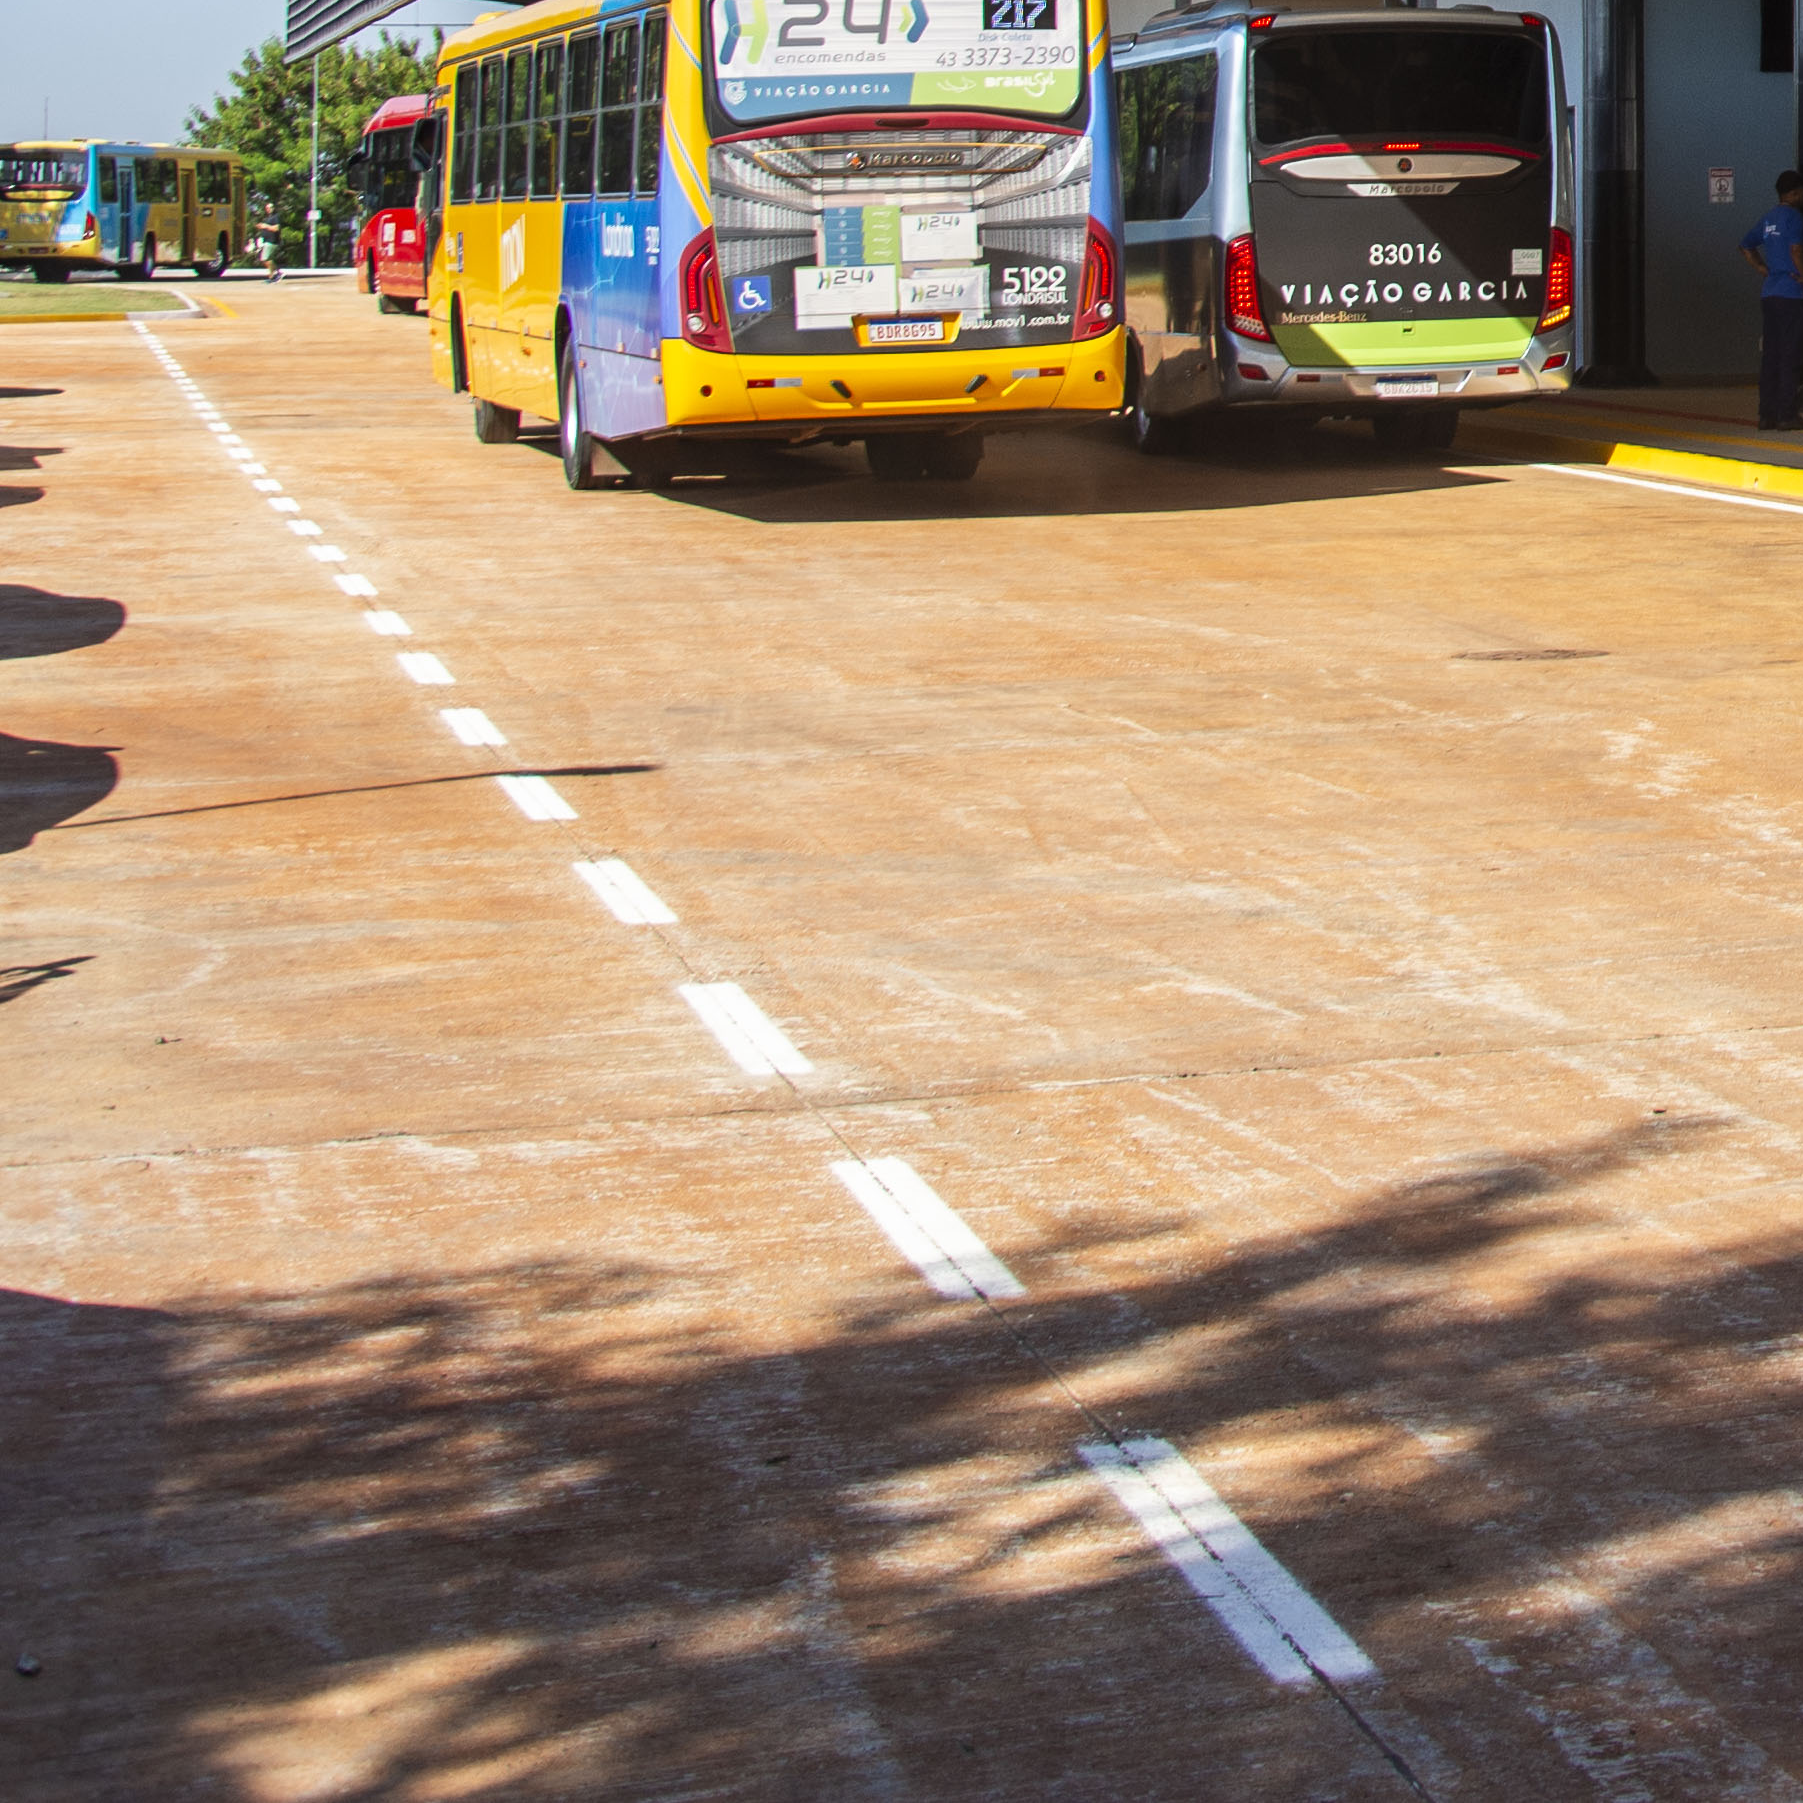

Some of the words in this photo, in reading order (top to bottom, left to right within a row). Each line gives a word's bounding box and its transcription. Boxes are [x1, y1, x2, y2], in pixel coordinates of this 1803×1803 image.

[774, 50, 886, 64] encomendas
[936, 52, 957, 67] 43
[963, 46, 1076, 67] 3373-2390
[754, 83, 820, 98] VIAÇÃO
[825, 83, 891, 96] GARCIA
[867, 151, 962, 167] Marcopolo
[1369, 183, 1446, 195] Marcopolo
[1369, 243, 1443, 267] 83016
[1003, 265, 1067, 293] 5122
[1002, 291, 1069, 306] LONDRISUL
[1280, 280, 1404, 307] VIAÇÃO
[1412, 280, 1528, 303] GARCIA
[1281, 311, 1368, 324] Mercedes-Benz
[877, 324, 936, 339] BDR8G95
